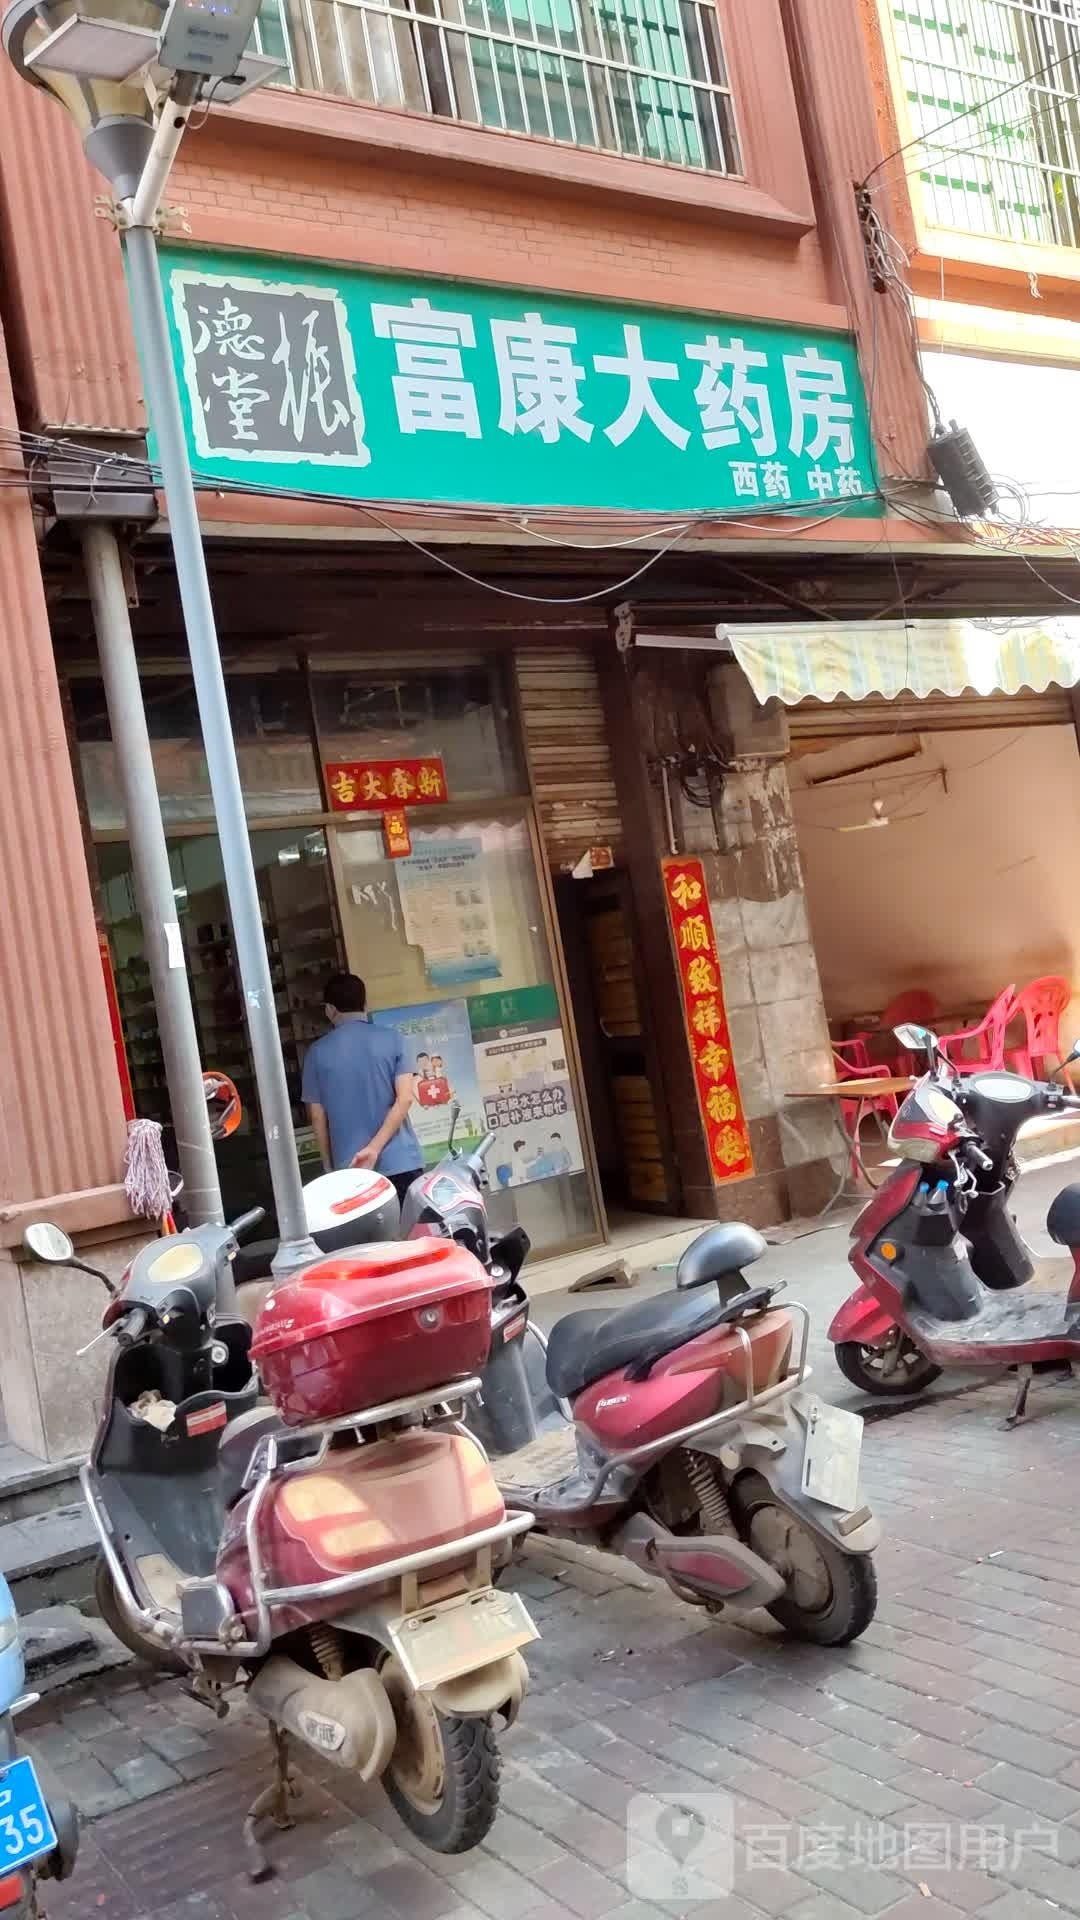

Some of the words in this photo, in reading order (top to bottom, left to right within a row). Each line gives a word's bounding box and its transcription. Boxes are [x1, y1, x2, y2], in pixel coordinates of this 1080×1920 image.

[370, 298, 855, 463] 富康大药房
[728, 461, 791, 499] 西药
[807, 464, 862, 499] 中药
